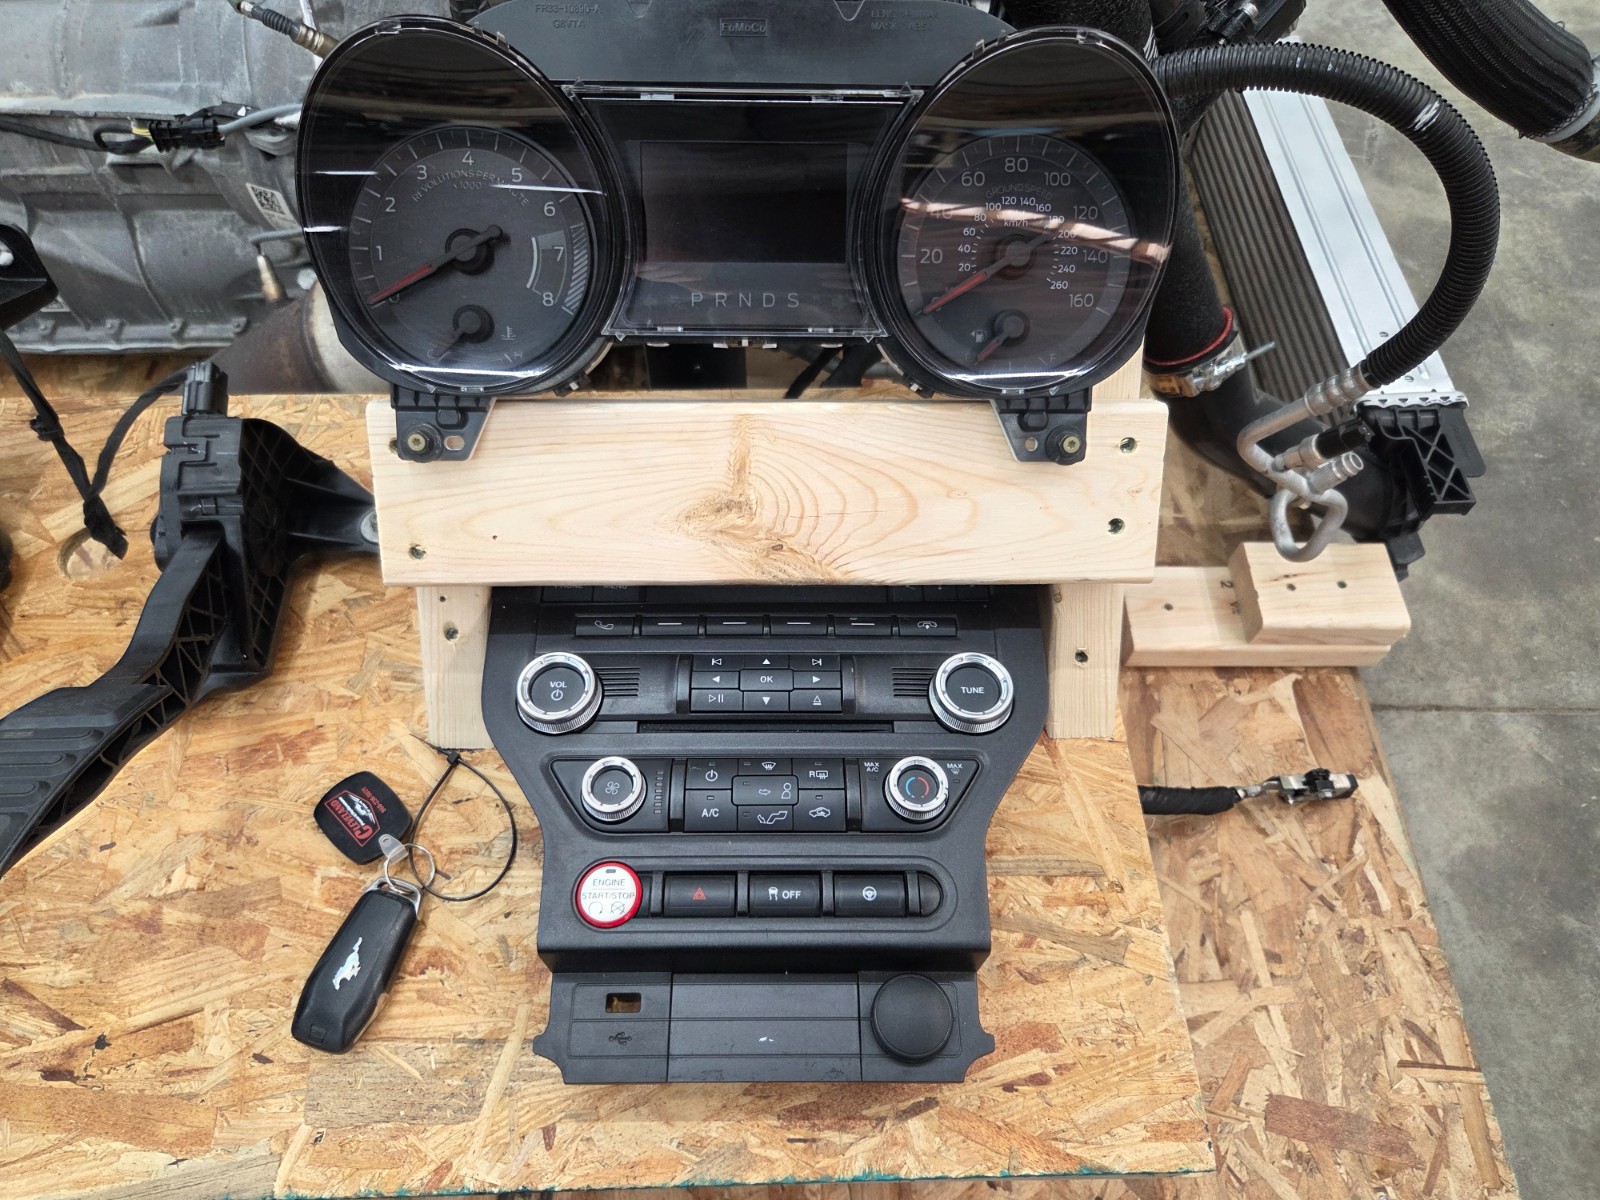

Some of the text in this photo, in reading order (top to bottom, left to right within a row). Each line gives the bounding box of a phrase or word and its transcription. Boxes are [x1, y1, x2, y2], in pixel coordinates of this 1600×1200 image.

[721, 22, 766, 33] FoMoCo
[461, 151, 474, 166] 4
[1004, 157, 1029, 173] 80
[416, 165, 428, 180] 3
[511, 167, 523, 182] 5
[961, 171, 985, 187] 60
[1044, 172, 1071, 187] 100
[985, 183, 1053, 200] GROUND SPEED
[384, 197, 396, 212] 2
[1002, 196, 1017, 205] 120
[1020, 197, 1036, 206] 140
[543, 202, 556, 217] 6
[985, 202, 1001, 211] 100
[1036, 203, 1051, 212] 160
[974, 212, 987, 222] 80
[1073, 205, 1098, 220] 120
[1003, 219, 1029, 227] km/h
[963, 227, 976, 236] 60
[1058, 230, 1076, 239] 200
[376, 245, 383, 261] 1
[957, 244, 971, 253] 40
[1061, 246, 1078, 255] 220
[553, 246, 565, 262] 7
[919, 248, 943, 264] 20
[1082, 250, 1108, 264] 140
[958, 263, 971, 272] 20
[1058, 264, 1076, 273] 240
[1050, 281, 1069, 290] 260
[542, 292, 555, 307] 8
[691, 292, 800, 307] P R N D S
[1069, 293, 1094, 308] 160
[760, 675, 774, 683] OK
[960, 686, 985, 694] TUNE
[701, 808, 720, 818] A/C
[330, 799, 373, 840] CLEVELAND
[592, 878, 626, 887] ENGINE
[582, 891, 636, 900] START/STOP
[782, 890, 802, 900] OFF
